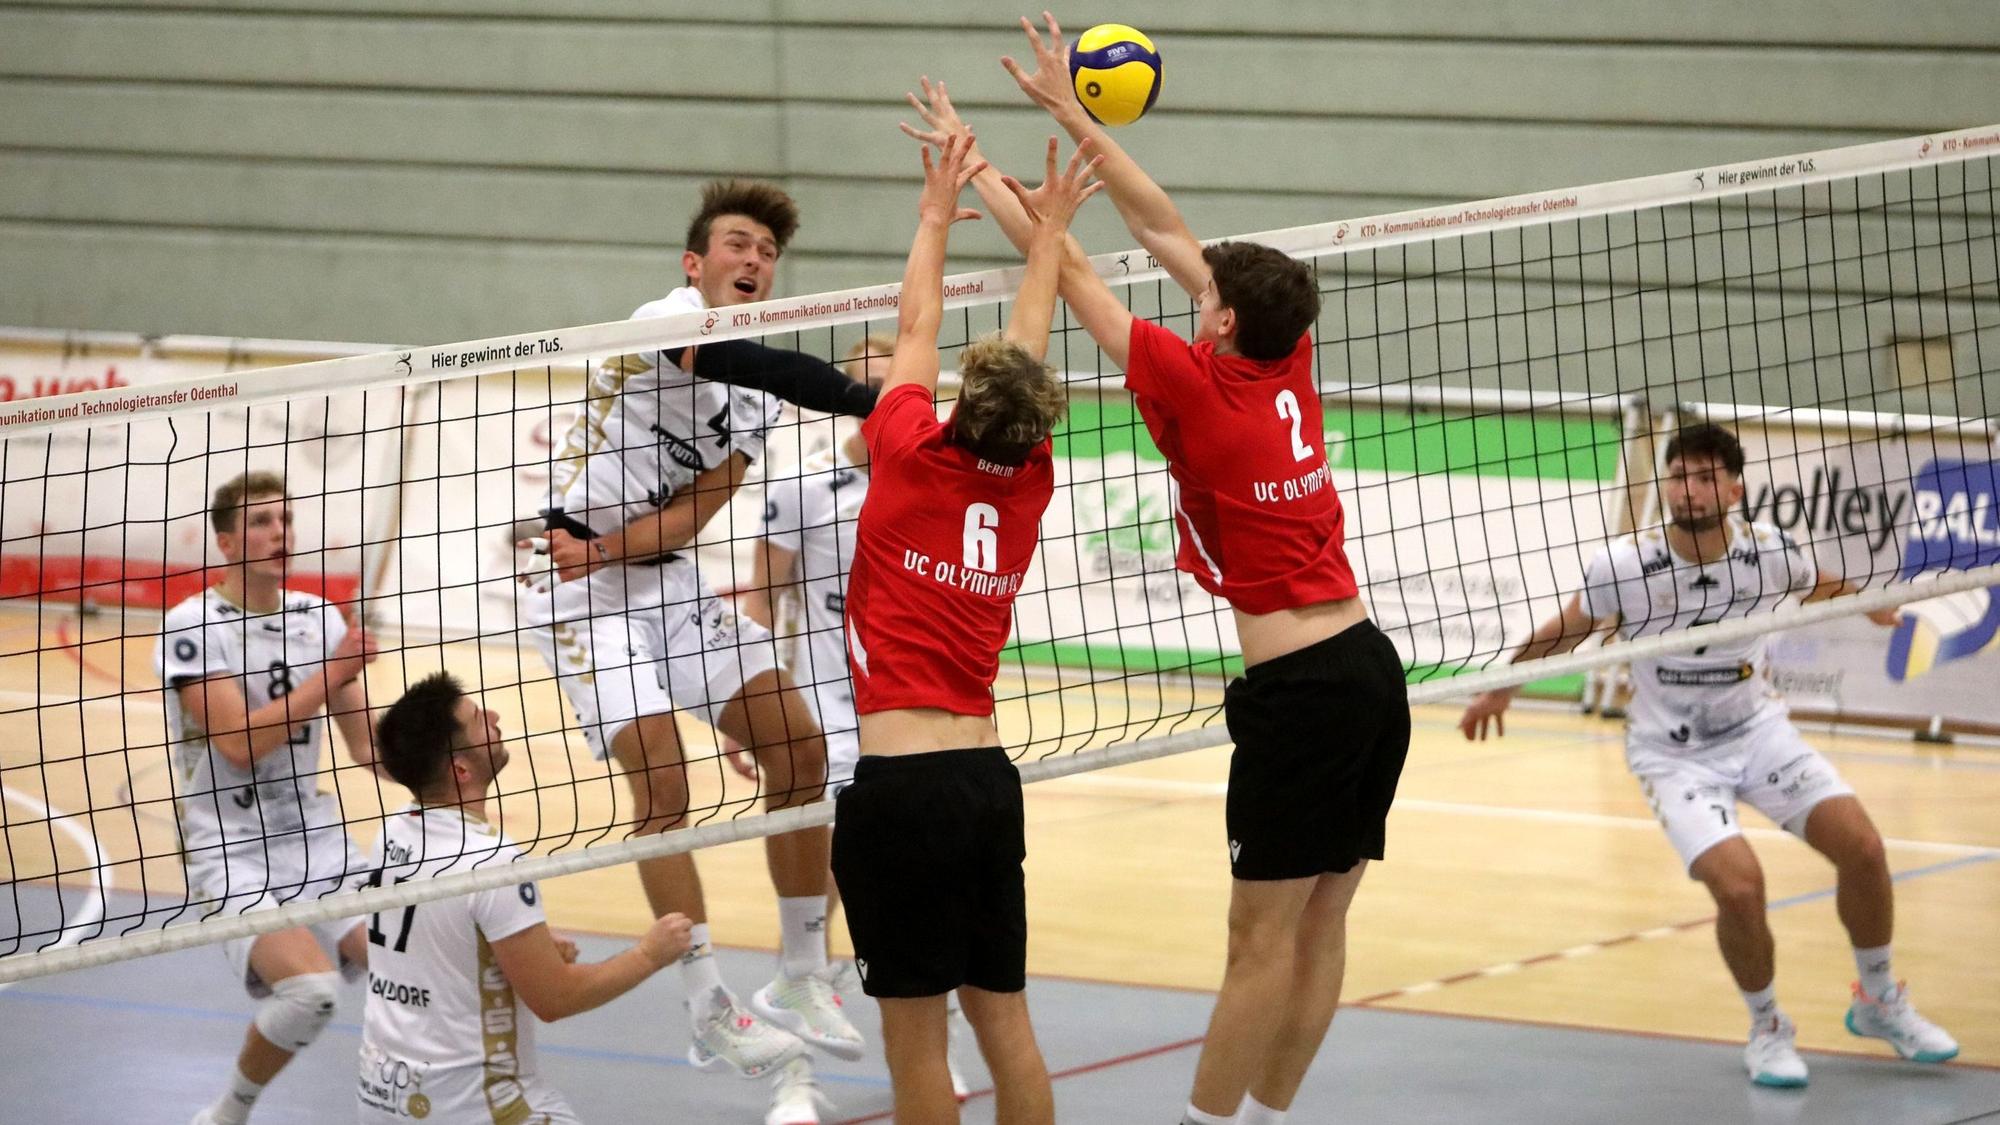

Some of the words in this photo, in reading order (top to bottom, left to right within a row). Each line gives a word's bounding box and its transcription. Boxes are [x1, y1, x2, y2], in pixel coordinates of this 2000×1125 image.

[1718, 169, 1738, 185] Hier
[1740, 163, 1777, 184] gewinnt
[1779, 160, 1796, 176] der
[1798, 158, 1817, 173] TuS.
[1361, 219, 1377, 237] KTO
[1383, 214, 1446, 235] Kommunikation
[1448, 212, 1463, 225] und
[1465, 200, 1541, 222] Technologietransfer
[1543, 195, 1578, 211] Odenthal
[1146, 255, 1162, 269] Tu
[732, 314, 751, 328] KTO
[759, 304, 833, 323] Kommunikation
[833, 299, 851, 313] und
[853, 291, 902, 311] Technologi
[943, 281, 984, 298] Odenthal
[431, 351, 458, 369] Hier
[460, 346, 511, 368] gewinnt
[514, 341, 536, 357] der
[538, 337, 563, 353] TuS.
[58, 402, 79, 419] und
[81, 389, 188, 416] Technologietransfer
[191, 382, 239, 401] Odenthal
[1275, 388, 1315, 463] 2
[977, 457, 1014, 478] BERLIN
[1253, 481, 1279, 502] UC
[1741, 465, 1908, 553] volley
[962, 502, 999, 573] 6
[903, 549, 930, 576] UC
[935, 561, 1008, 597] OLYMPIA
[267, 658, 292, 700] 8
[368, 869, 417, 953] 17
